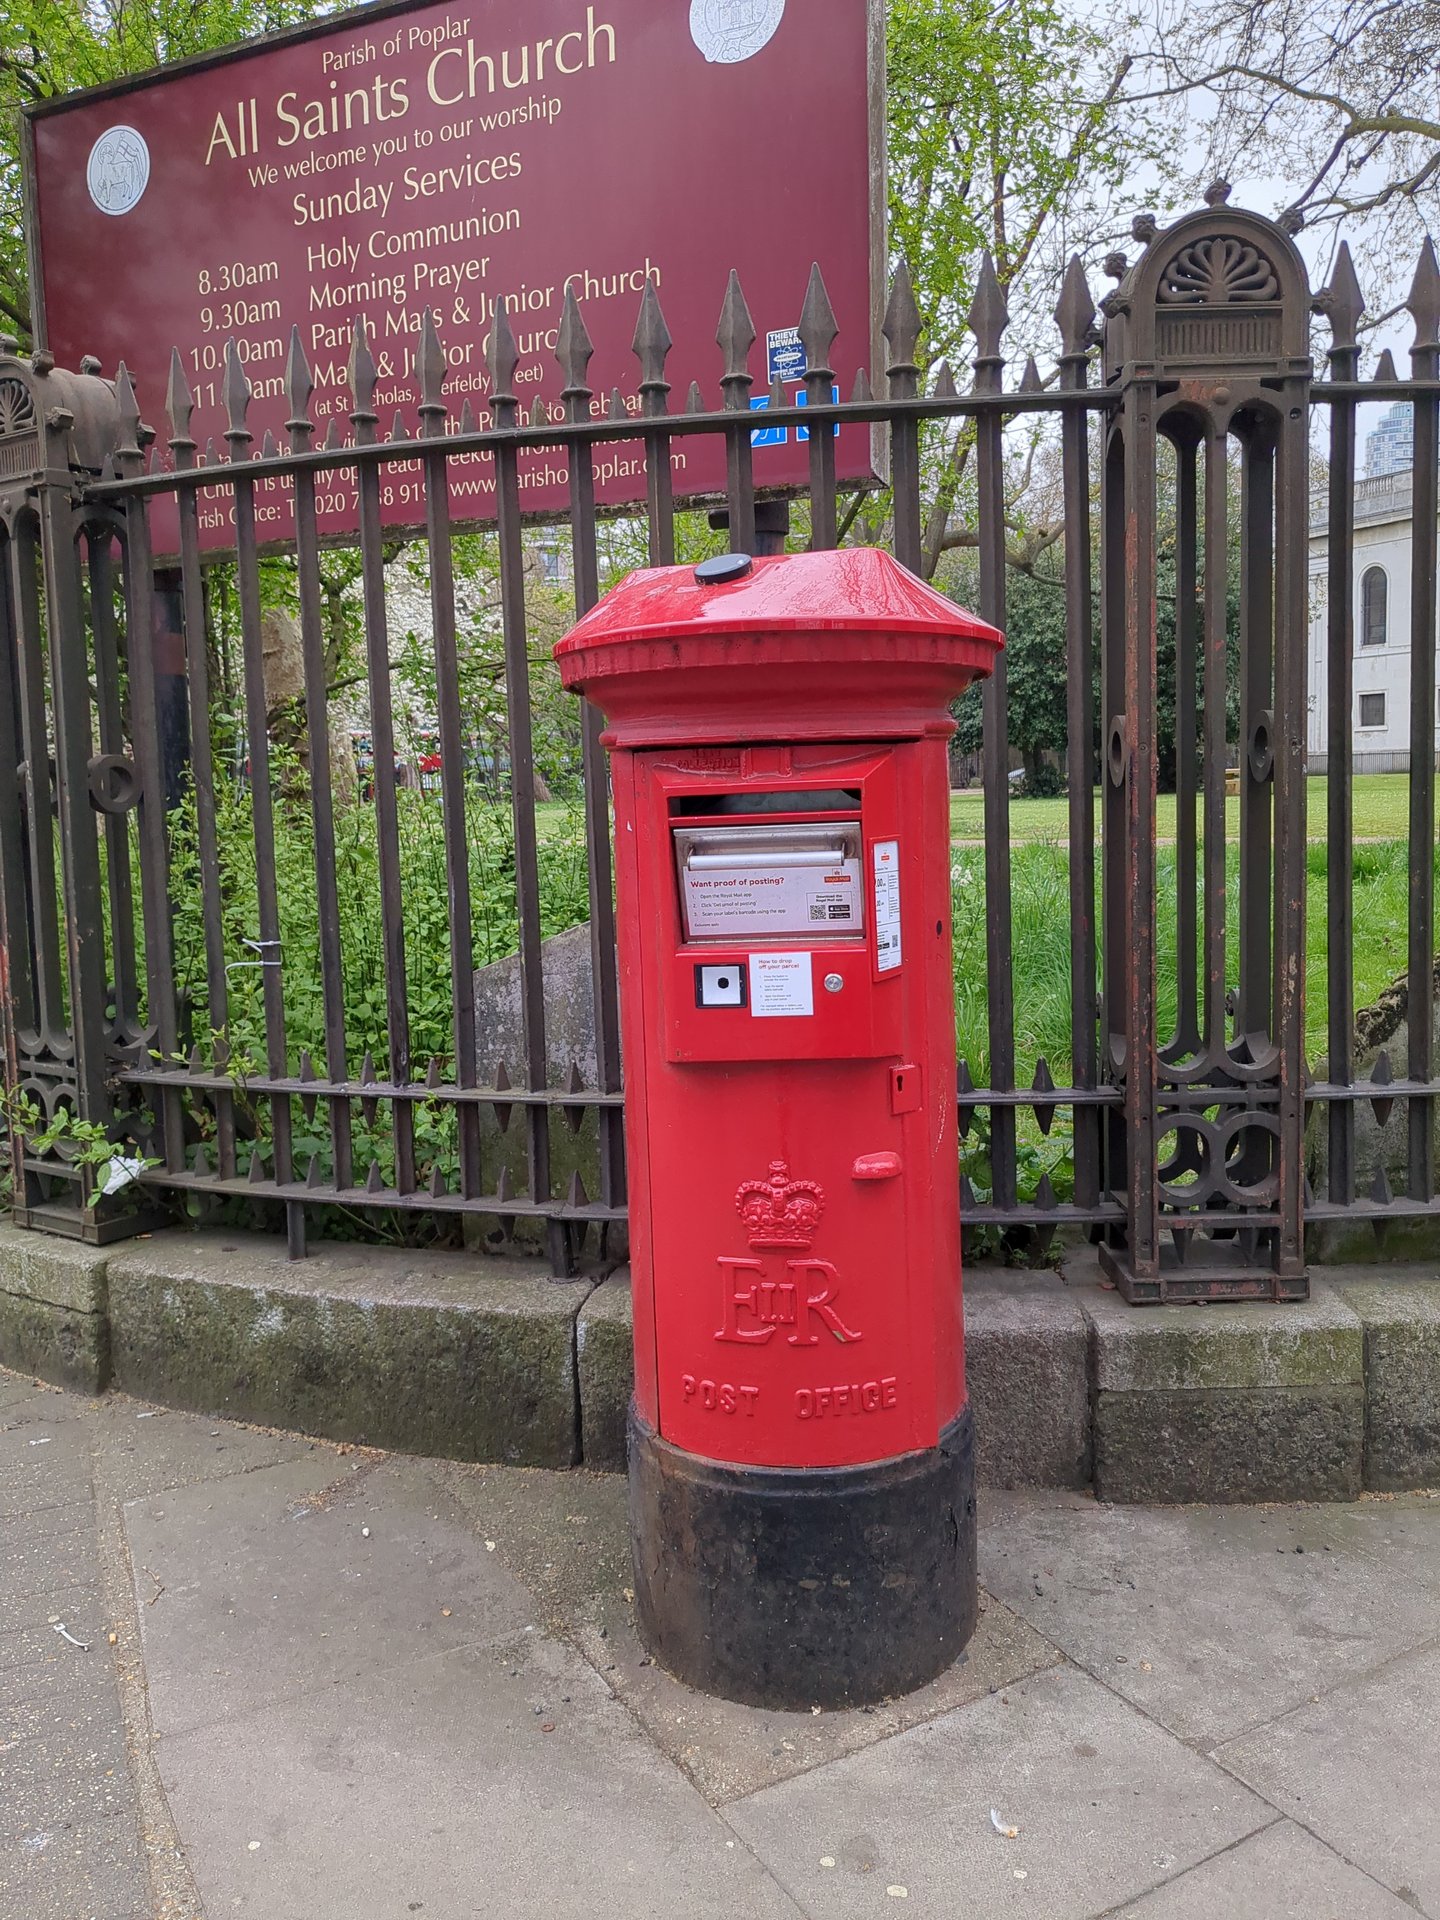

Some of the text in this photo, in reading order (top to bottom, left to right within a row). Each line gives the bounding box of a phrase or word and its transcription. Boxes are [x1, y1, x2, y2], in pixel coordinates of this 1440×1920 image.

[322, 16, 471, 74] Parish of Poplar
[205, 5, 617, 165] All Saints Church
[248, 96, 562, 188] We welcome you to our worship
[293, 151, 522, 226] Sunday Services
[199, 206, 521, 295] 8.30am Holy Communion
[200, 257, 490, 333] 9.30am Morning Prayer
[312, 313, 376, 350] Parih
[452, 297, 470, 324] &
[563, 257, 661, 303] Church
[770, 330, 798, 341] THIEVE
[770, 338, 801, 348] BEWAR
[377, 351, 394, 378] &
[315, 400, 331, 417] (at
[335, 396, 348, 412] St
[314, 493, 345, 514] 020
[713, 879, 737, 888] proof
[738, 878, 748, 886] of
[749, 877, 785, 886] posting?
[682, 1374, 897, 1419] POST OFFICE
